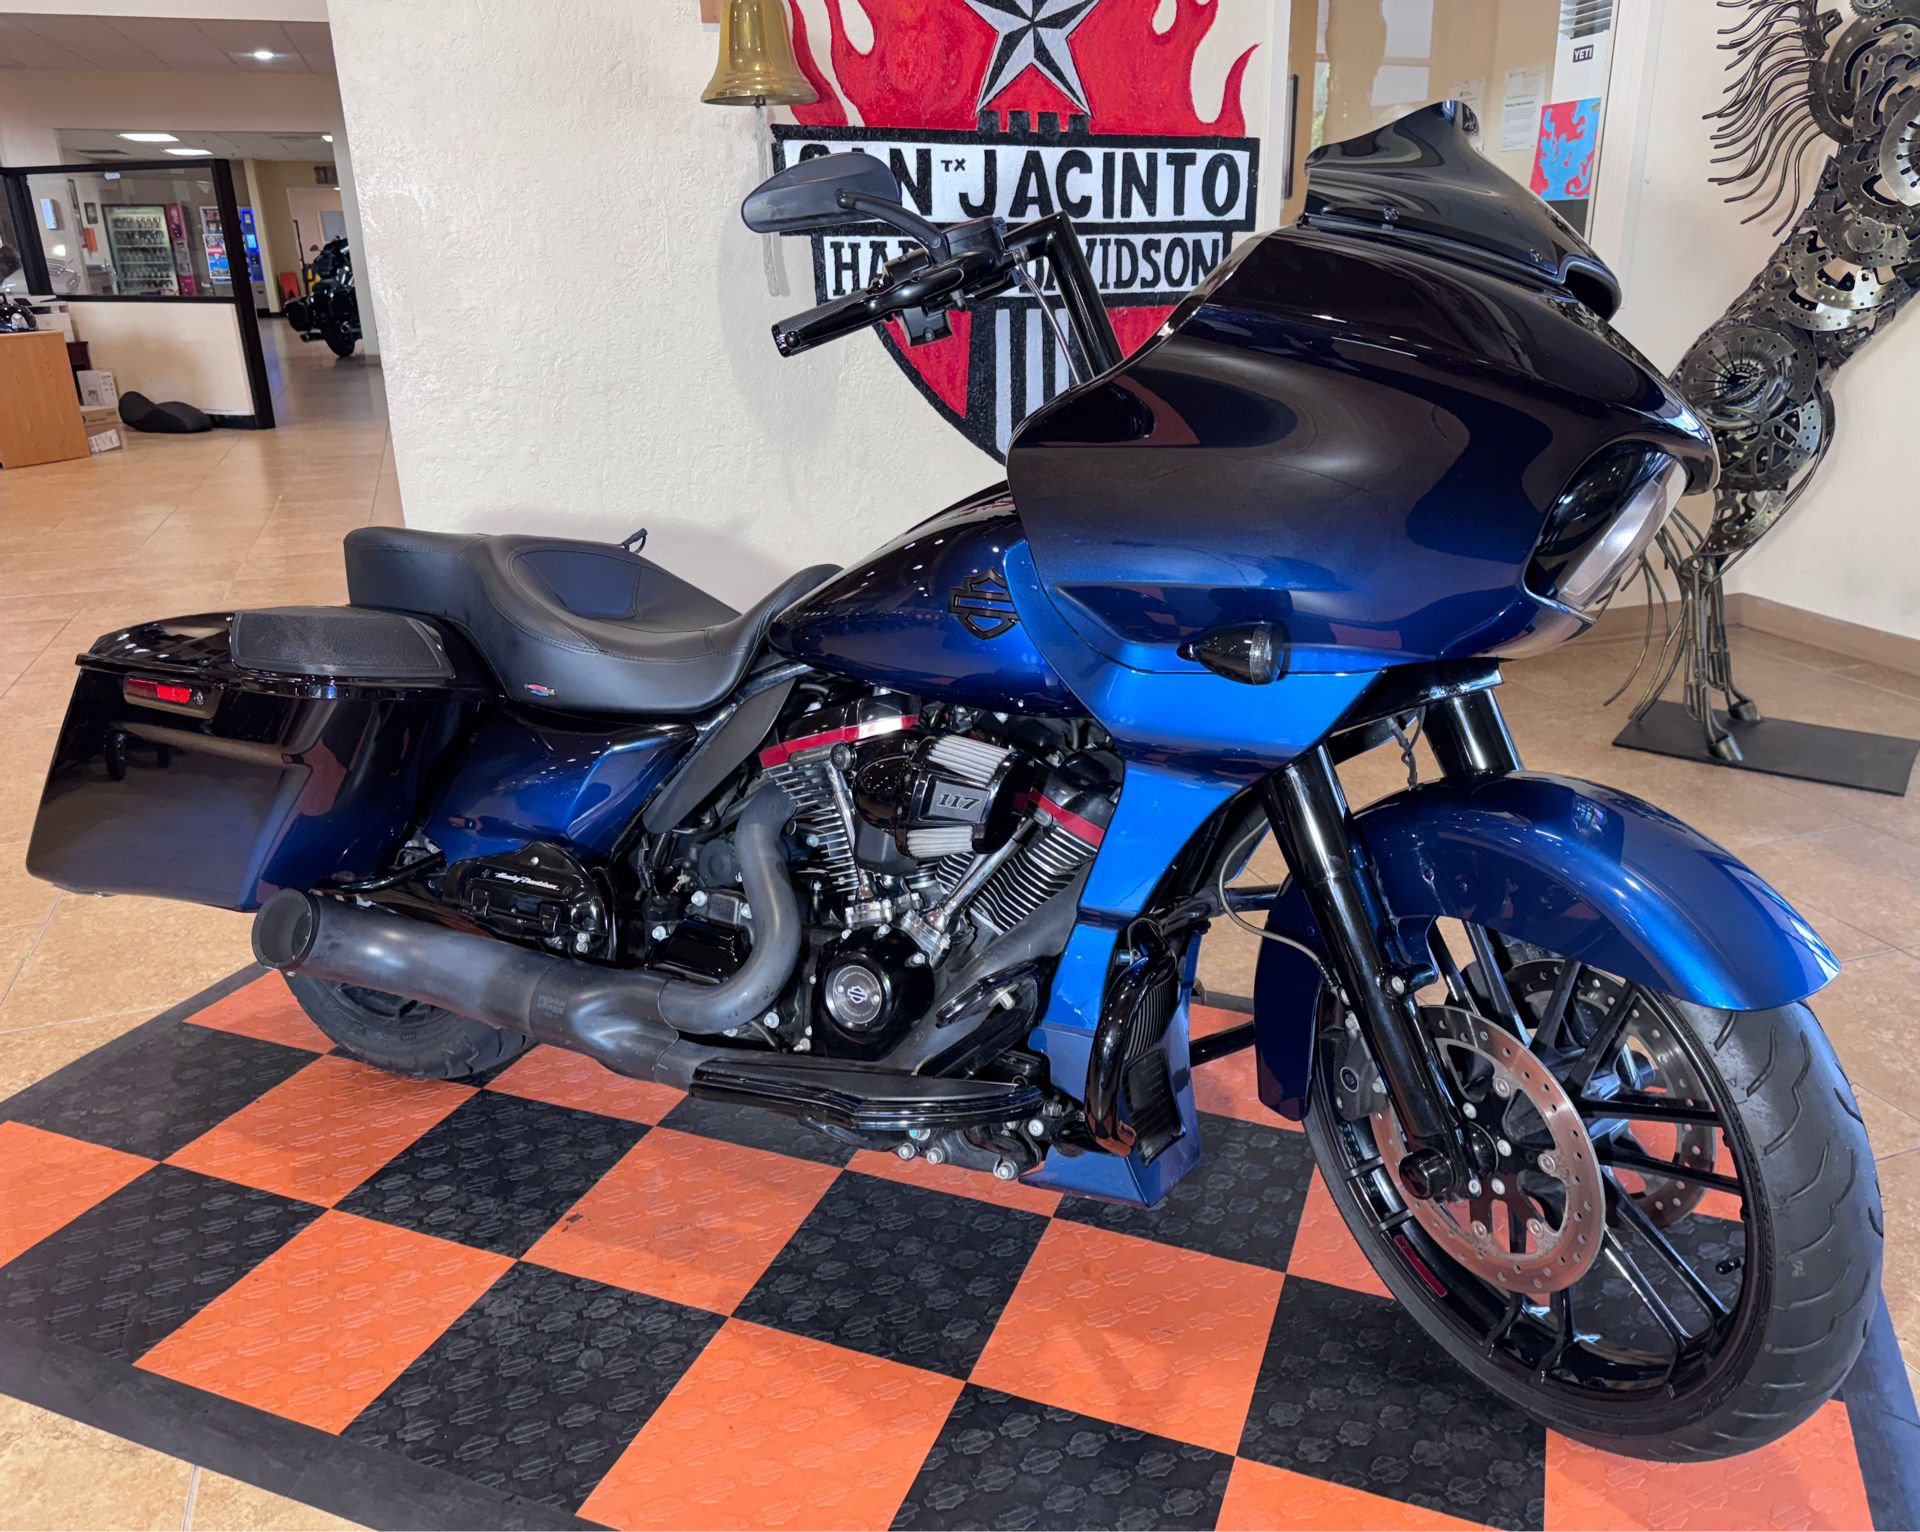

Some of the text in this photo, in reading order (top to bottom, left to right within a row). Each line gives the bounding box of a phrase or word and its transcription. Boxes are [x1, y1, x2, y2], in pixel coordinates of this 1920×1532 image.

[1574, 45, 1592, 61] YETI
[940, 157, 967, 172] TX
[958, 148, 1241, 219] JACINTO
[936, 793, 982, 811] 117
